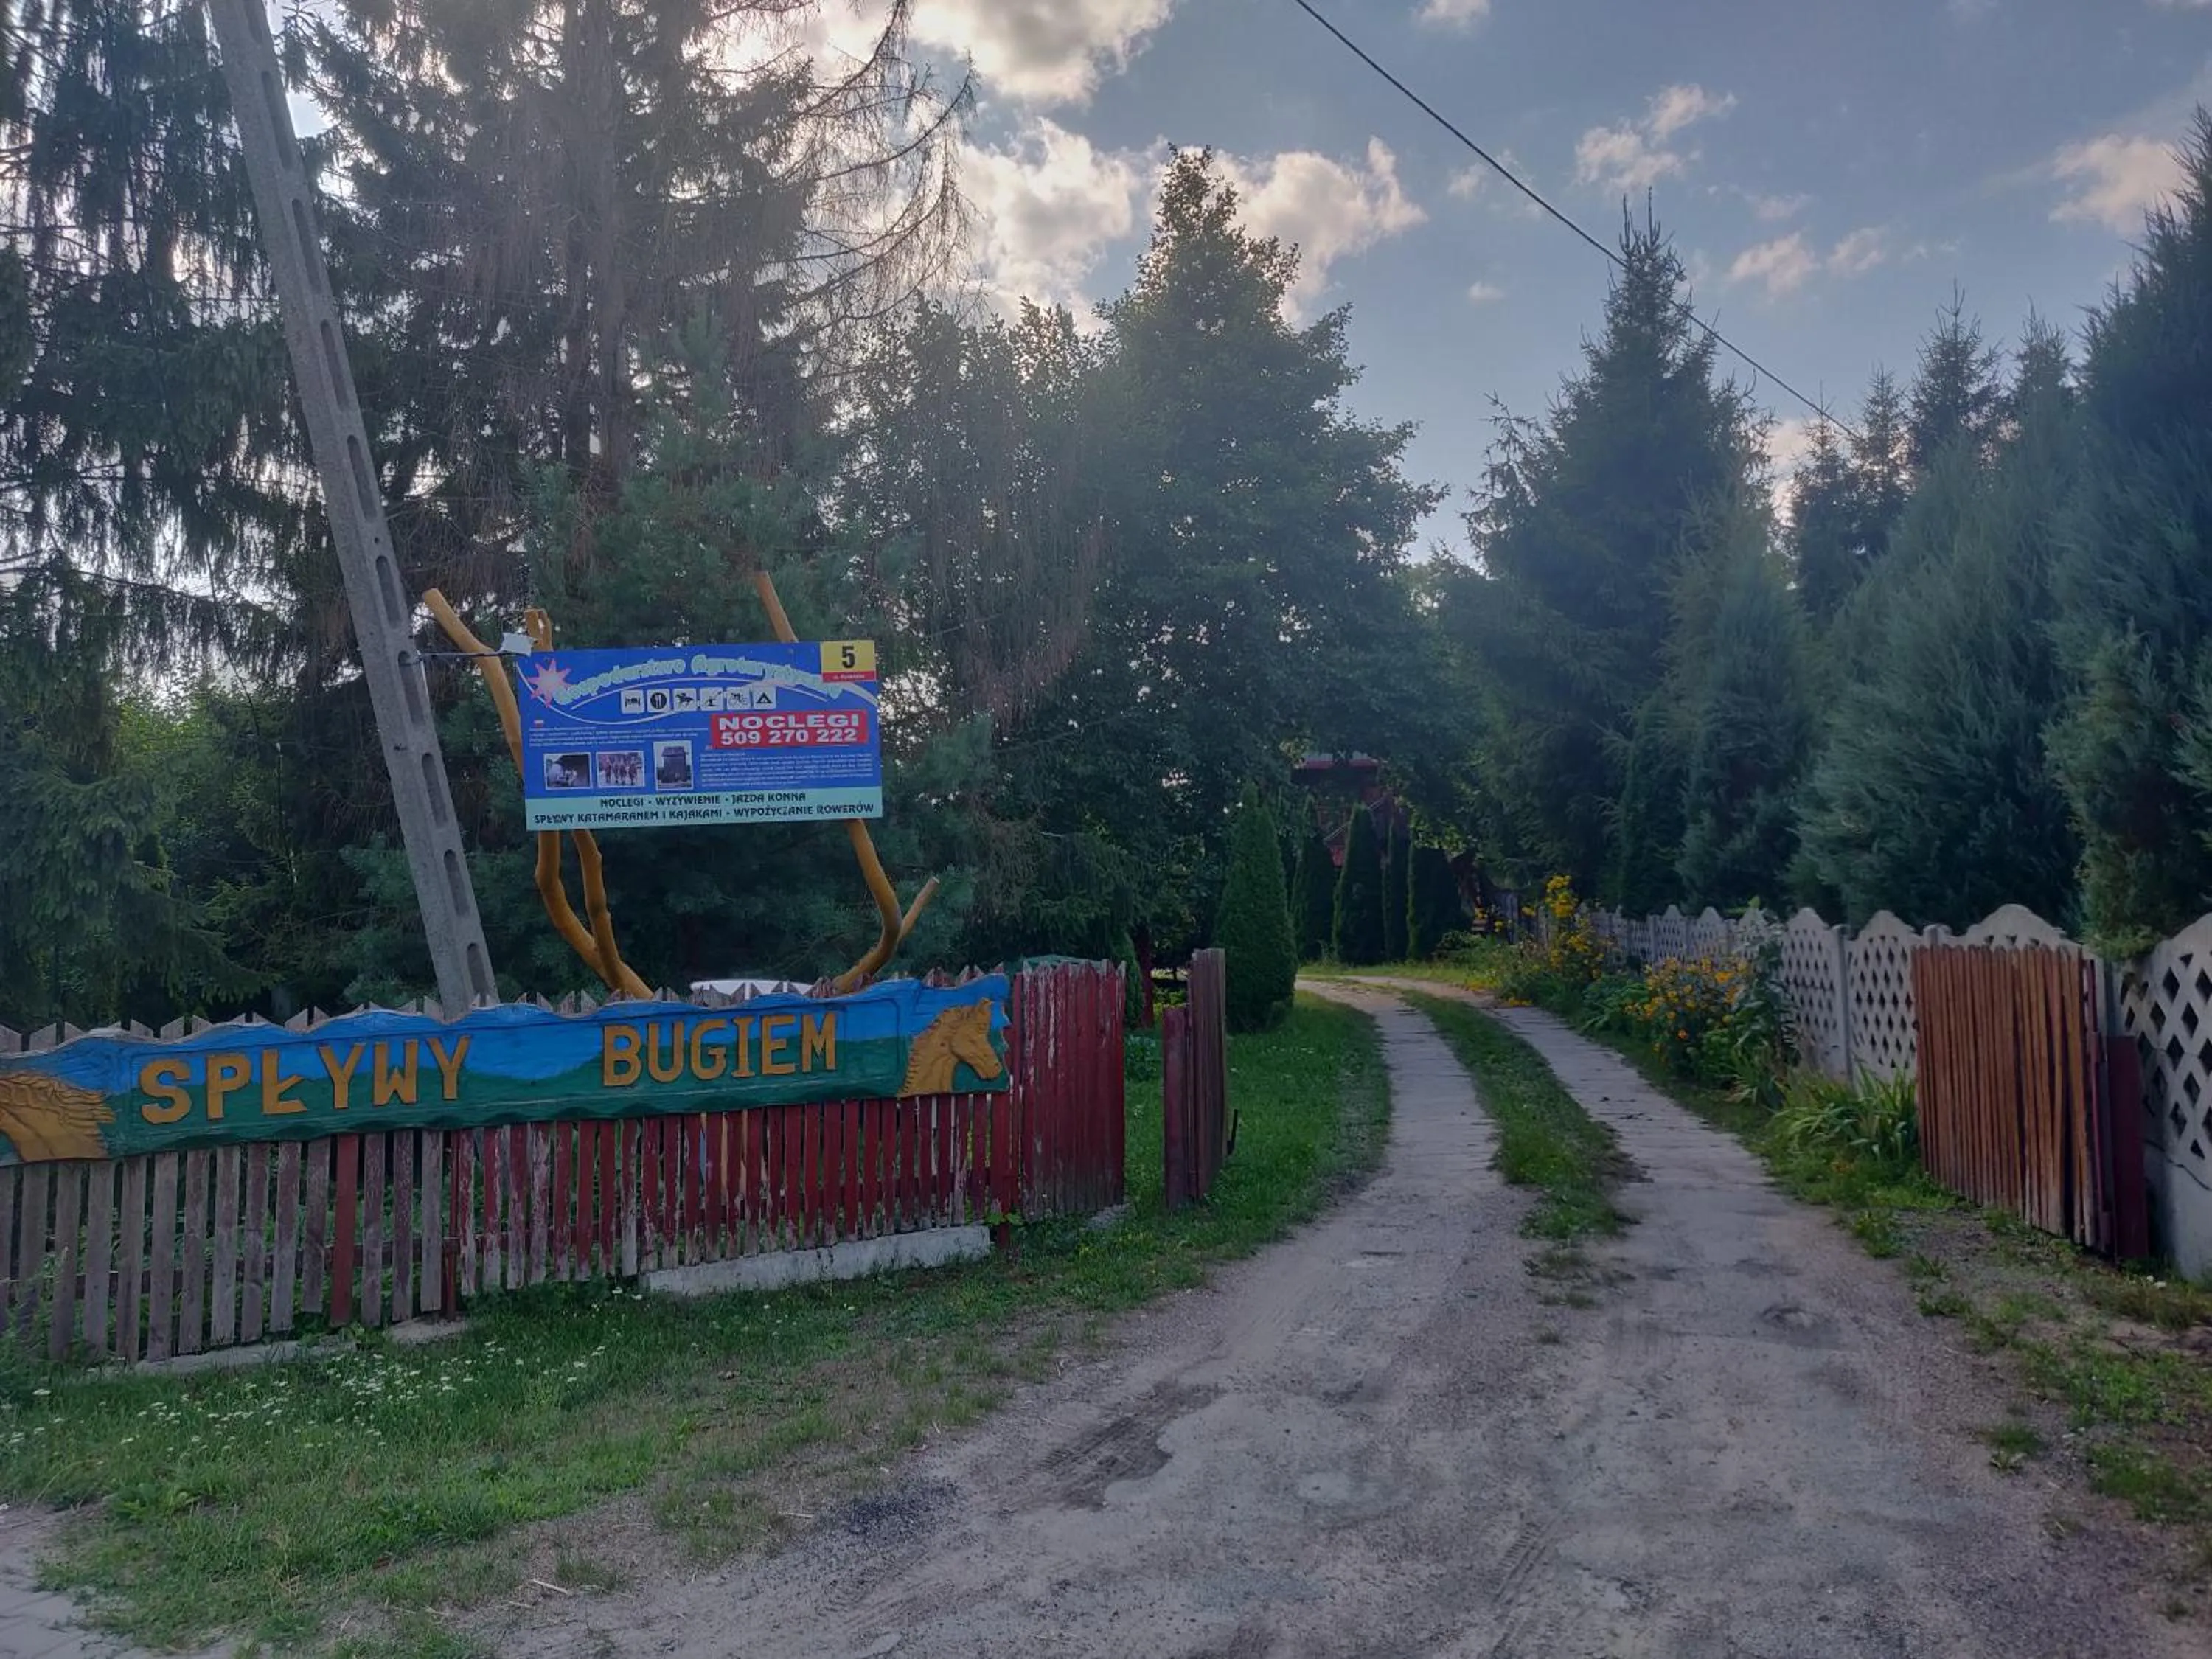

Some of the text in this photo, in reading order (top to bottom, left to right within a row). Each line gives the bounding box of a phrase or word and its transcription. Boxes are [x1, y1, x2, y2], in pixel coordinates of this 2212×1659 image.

[842, 646, 855, 668] 5
[719, 714, 860, 730] NOCLEGI
[720, 731, 762, 745] 509
[768, 729, 809, 743] 270
[816, 728, 857, 742] 222
[600, 798, 644, 808] NOCLEGI
[731, 793, 765, 804] JAZDA
[768, 793, 806, 802] KONNA
[577, 810, 658, 823] KATAMARANEM
[669, 808, 722, 820] KAJAKAMI
[734, 804, 813, 818] WYPOŻYCZANIE
[816, 801, 874, 815] ROWERÓW
[139, 1010, 836, 1124] SPŁYWY BUGIEM
